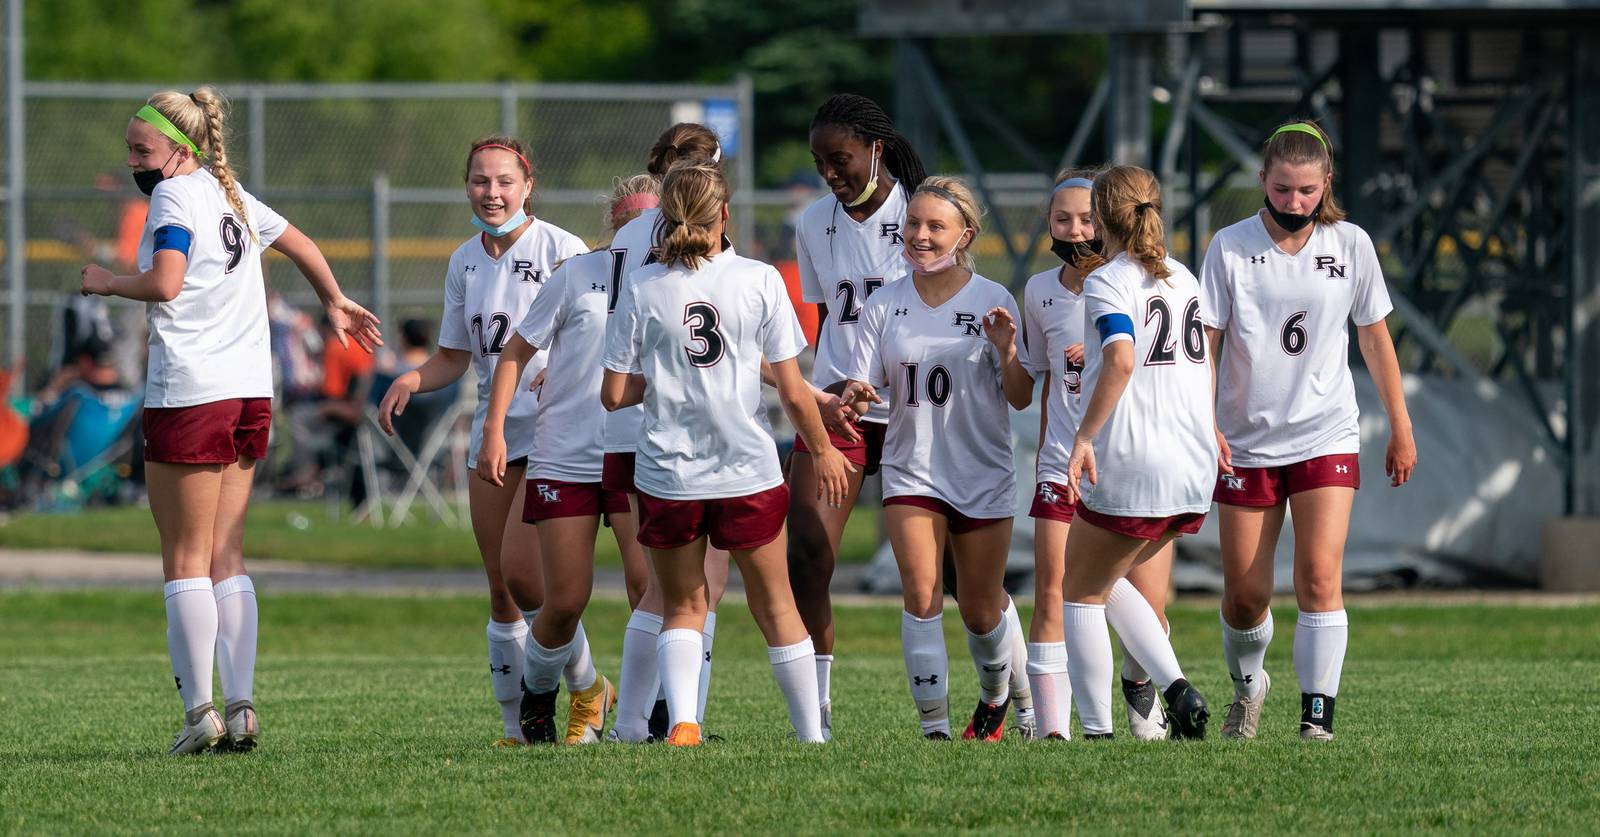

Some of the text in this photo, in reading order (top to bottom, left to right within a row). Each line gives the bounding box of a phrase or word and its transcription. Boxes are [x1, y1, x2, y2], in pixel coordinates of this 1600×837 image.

[219, 212, 246, 275] 9
[512, 259, 544, 285] PN
[1314, 255, 1348, 280] PN
[683, 300, 726, 368] 3
[953, 310, 985, 337] PN
[1143, 295, 1206, 367] 26
[1280, 311, 1308, 357] 6
[900, 362, 952, 408] 10
[536, 482, 562, 502] PN
